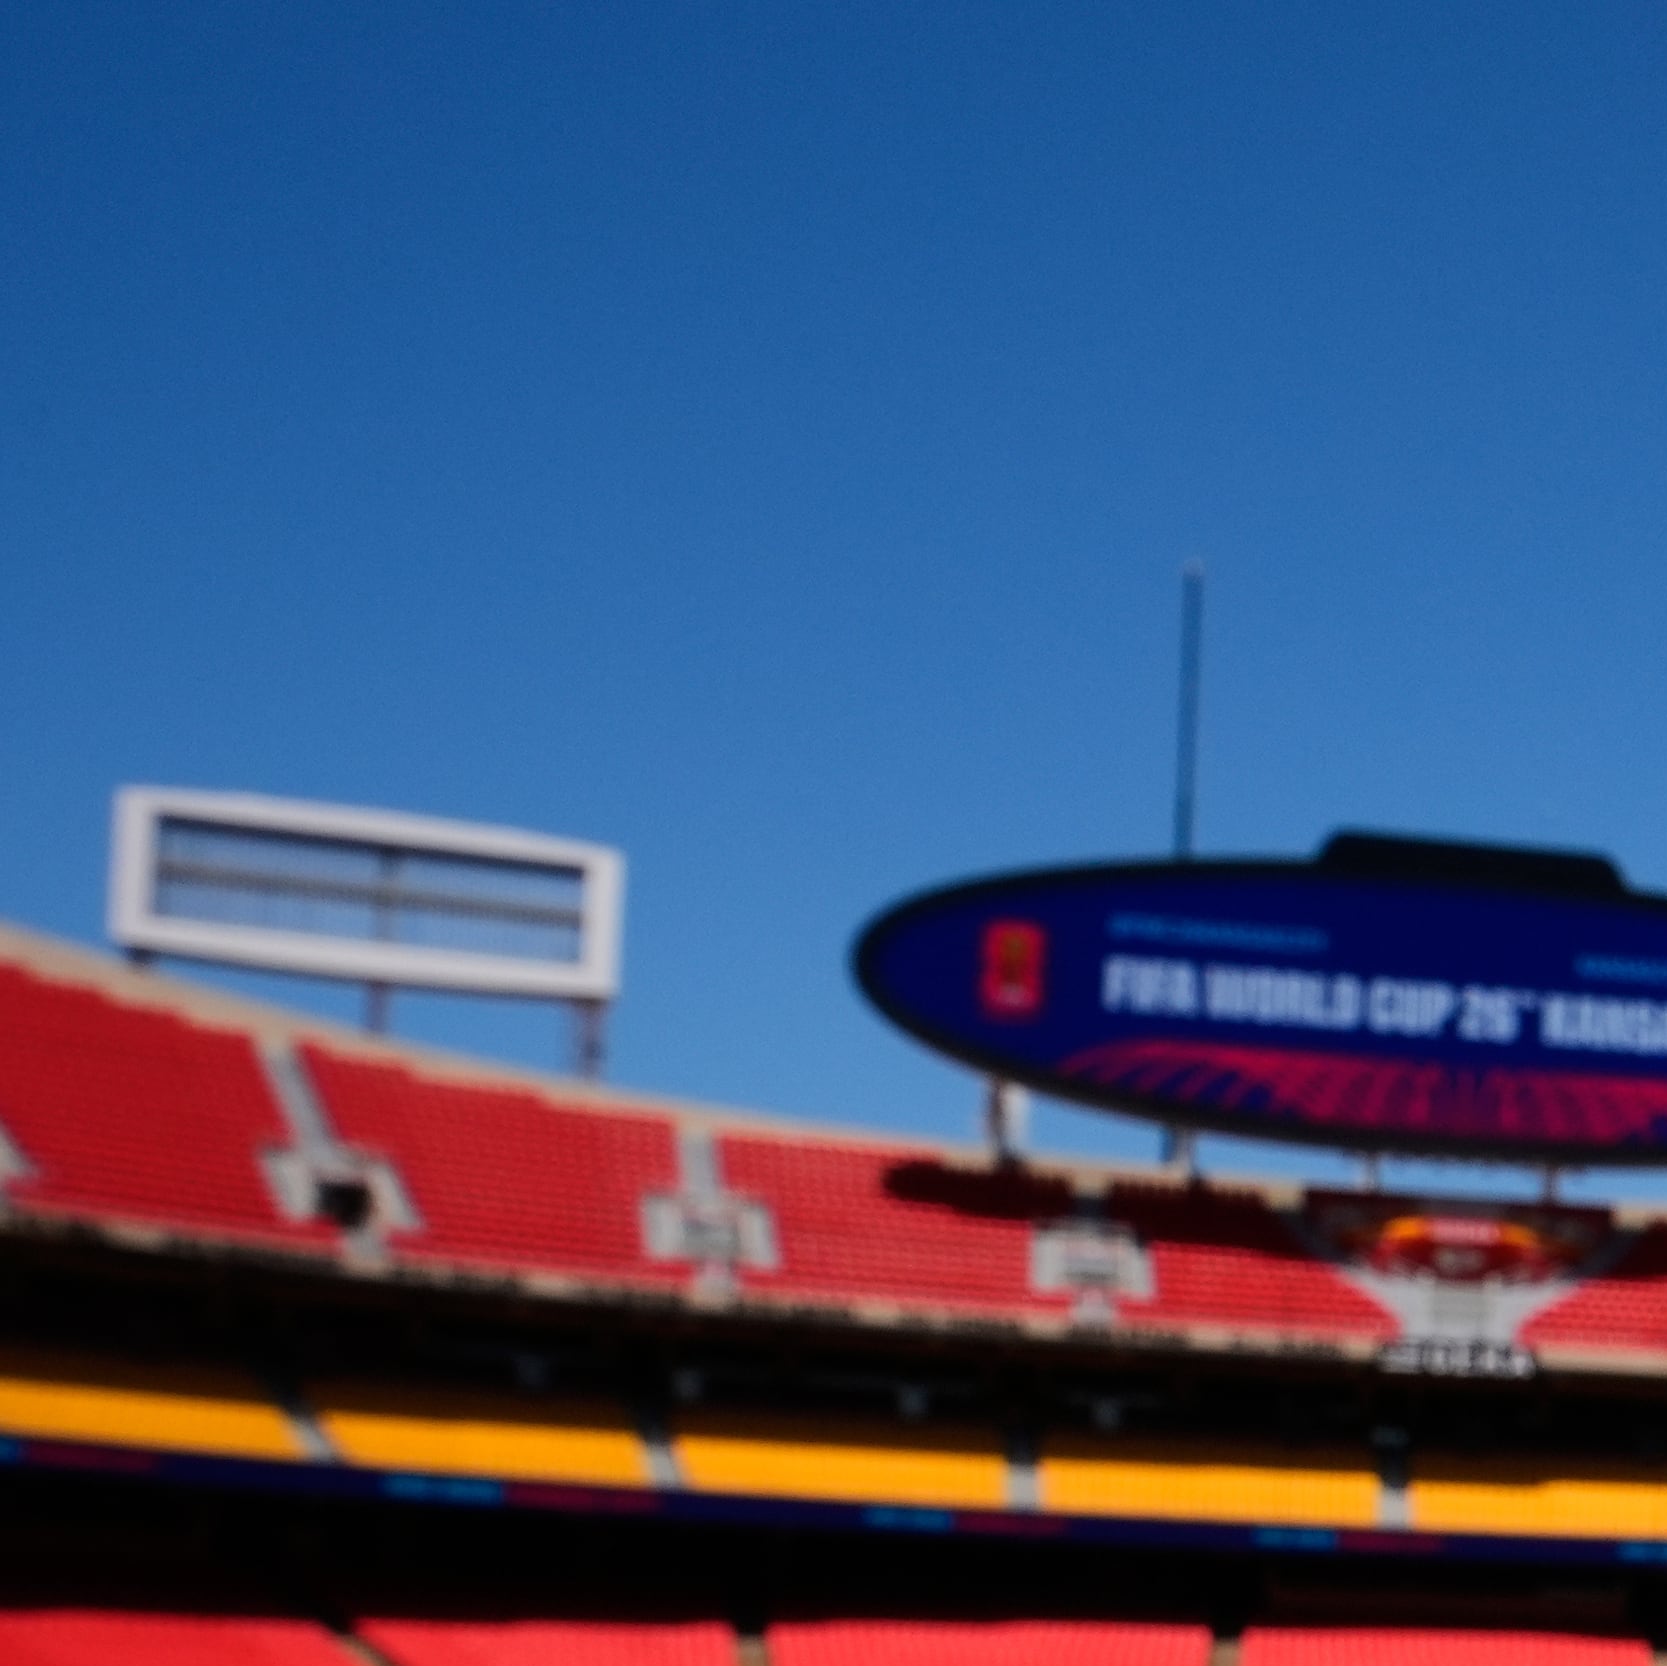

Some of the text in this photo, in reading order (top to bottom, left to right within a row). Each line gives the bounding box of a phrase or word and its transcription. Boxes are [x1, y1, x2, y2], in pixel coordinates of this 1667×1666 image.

[1103, 954, 1198, 1018] FIFA
[1203, 962, 1361, 1031] WORLD
[1365, 975, 1454, 1037] CUP
